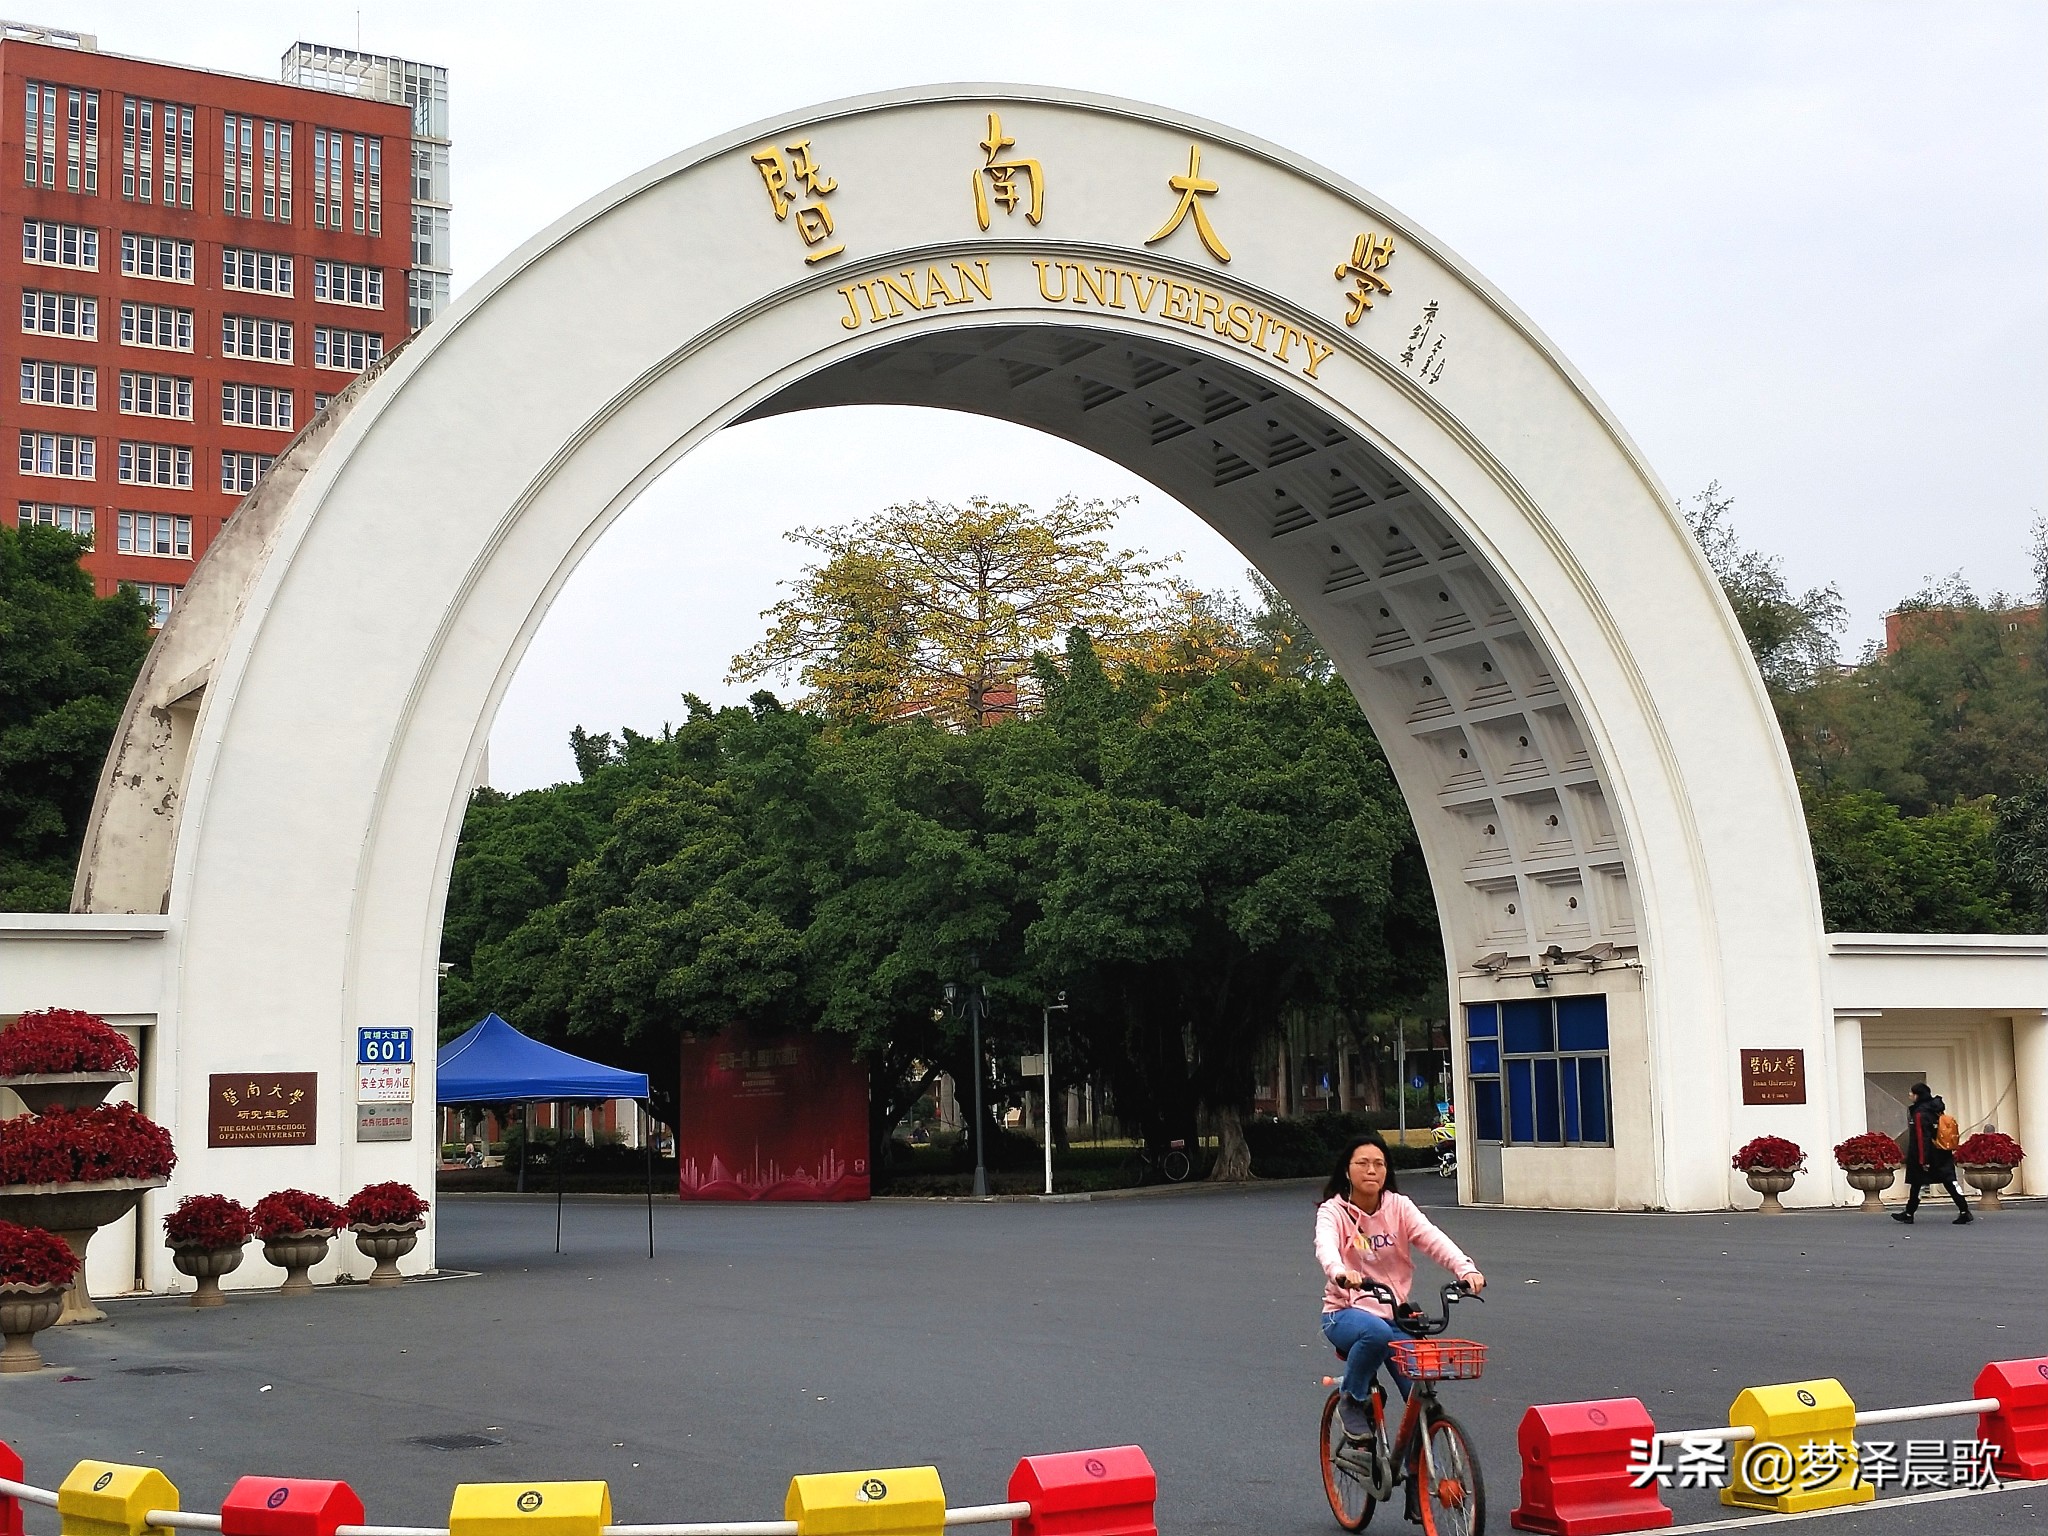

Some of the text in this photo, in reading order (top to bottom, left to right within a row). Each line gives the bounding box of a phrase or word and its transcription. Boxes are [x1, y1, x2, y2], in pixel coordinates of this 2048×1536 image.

[838, 260, 1336, 380] JINAN UNIVERSITY
[363, 1030, 409, 1040] 黄埔大道西
[366, 1041, 406, 1060] 601
[368, 1067, 402, 1075] 广州市
[360, 1077, 410, 1089] 安全文明小区
[236, 1109, 290, 1120] 研究生院
[235, 1124, 276, 1132] GRADUATE
[278, 1123, 307, 1131] SCHOOL
[257, 1131, 307, 1139] UNIVERSITY
